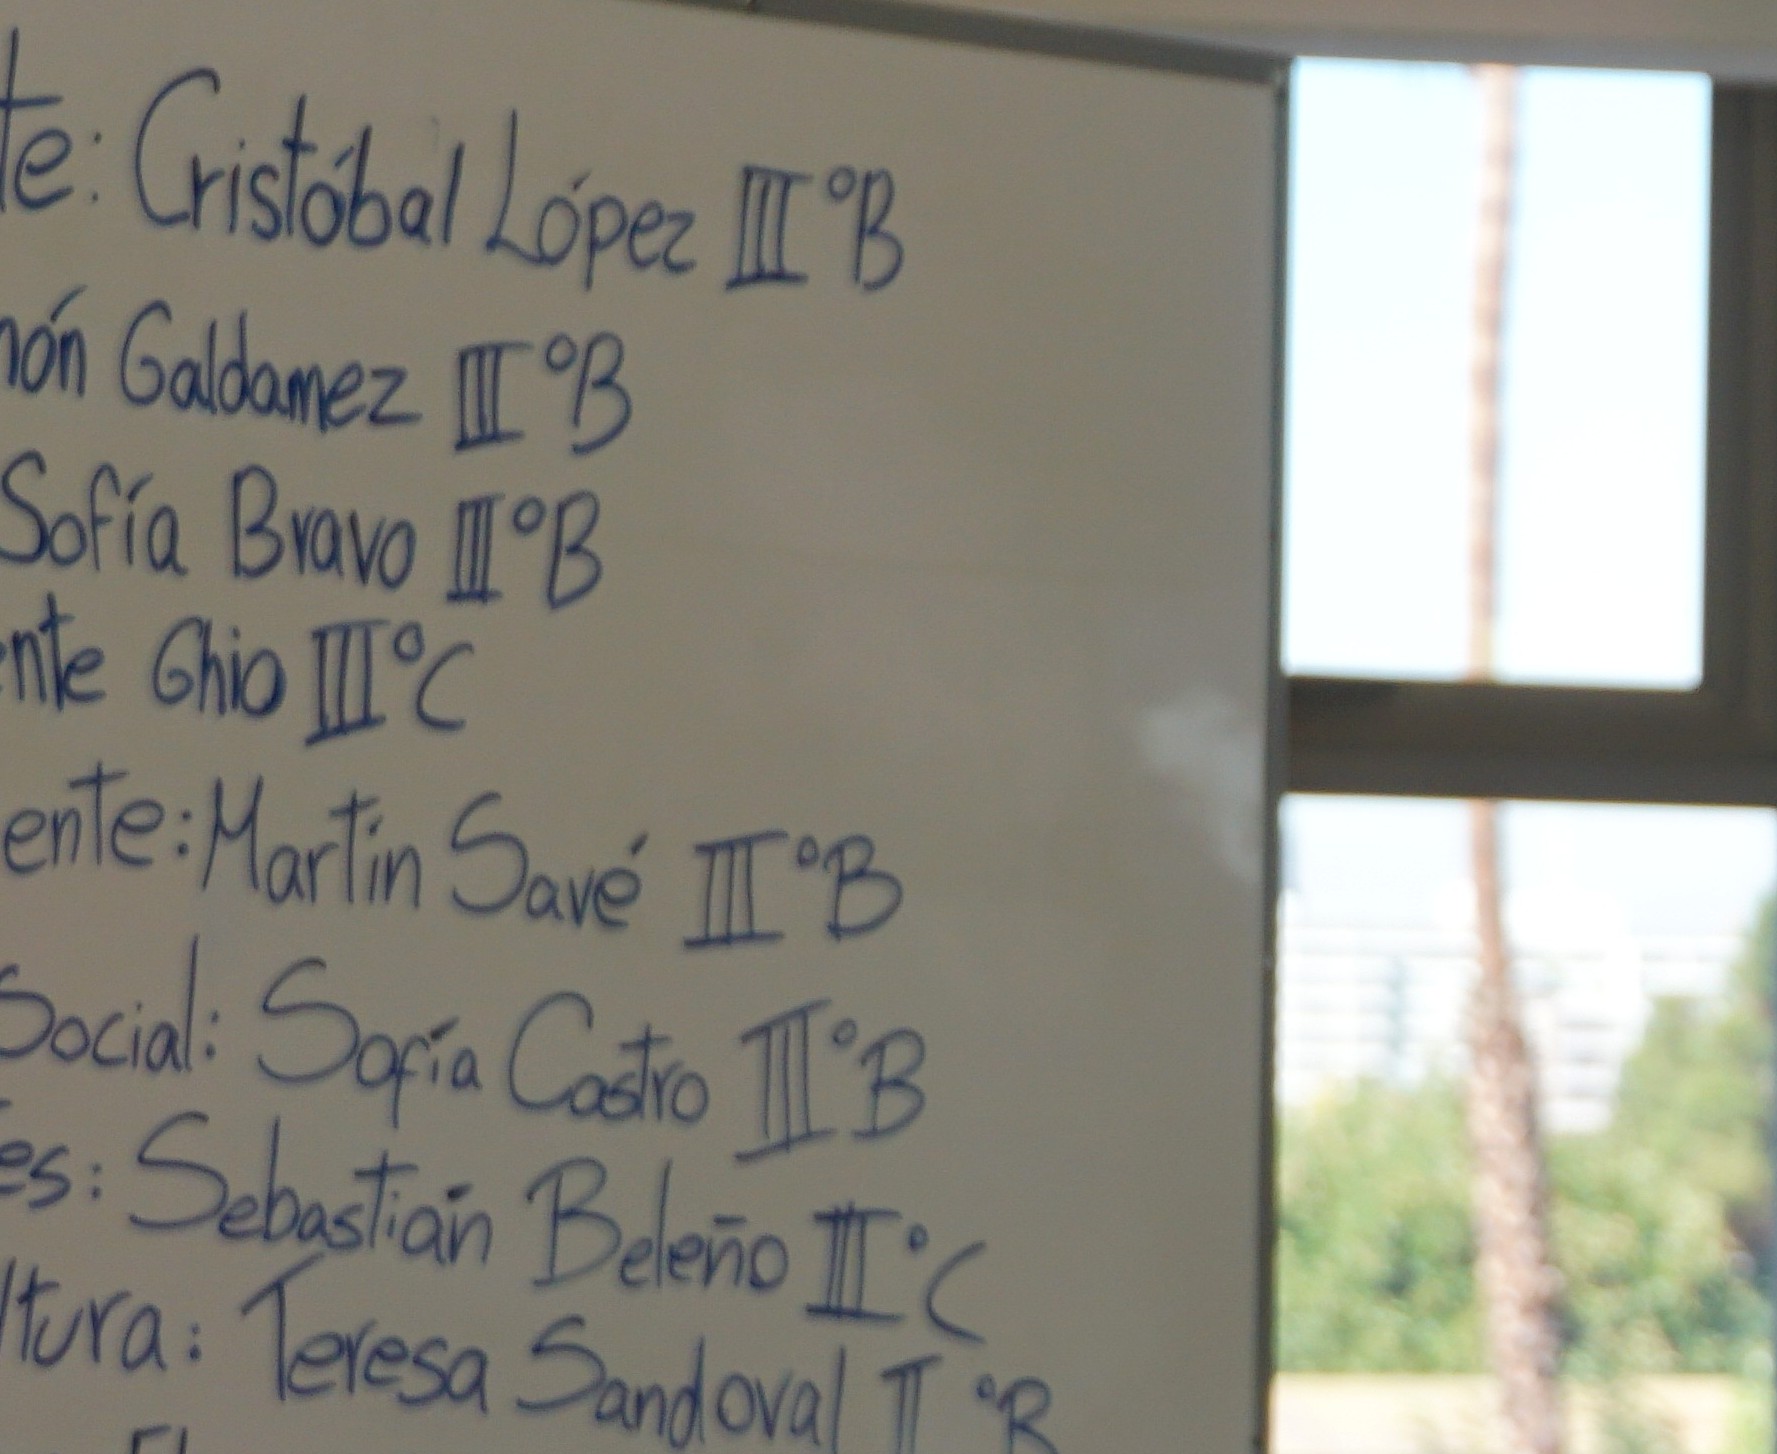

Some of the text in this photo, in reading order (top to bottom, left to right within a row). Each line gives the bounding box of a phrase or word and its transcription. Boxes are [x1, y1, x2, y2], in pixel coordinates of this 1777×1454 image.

[133, 68, 462, 249] Cristóbal
[485, 111, 693, 289] López
[120, 302, 420, 432] Galdamez
[230, 467, 414, 588] Bravo
[451, 794, 645, 927] Savé
[508, 994, 707, 1124] Castro
[242, 1255, 487, 1412] Teresa
[518, 1315, 847, 1454] Sandoval
